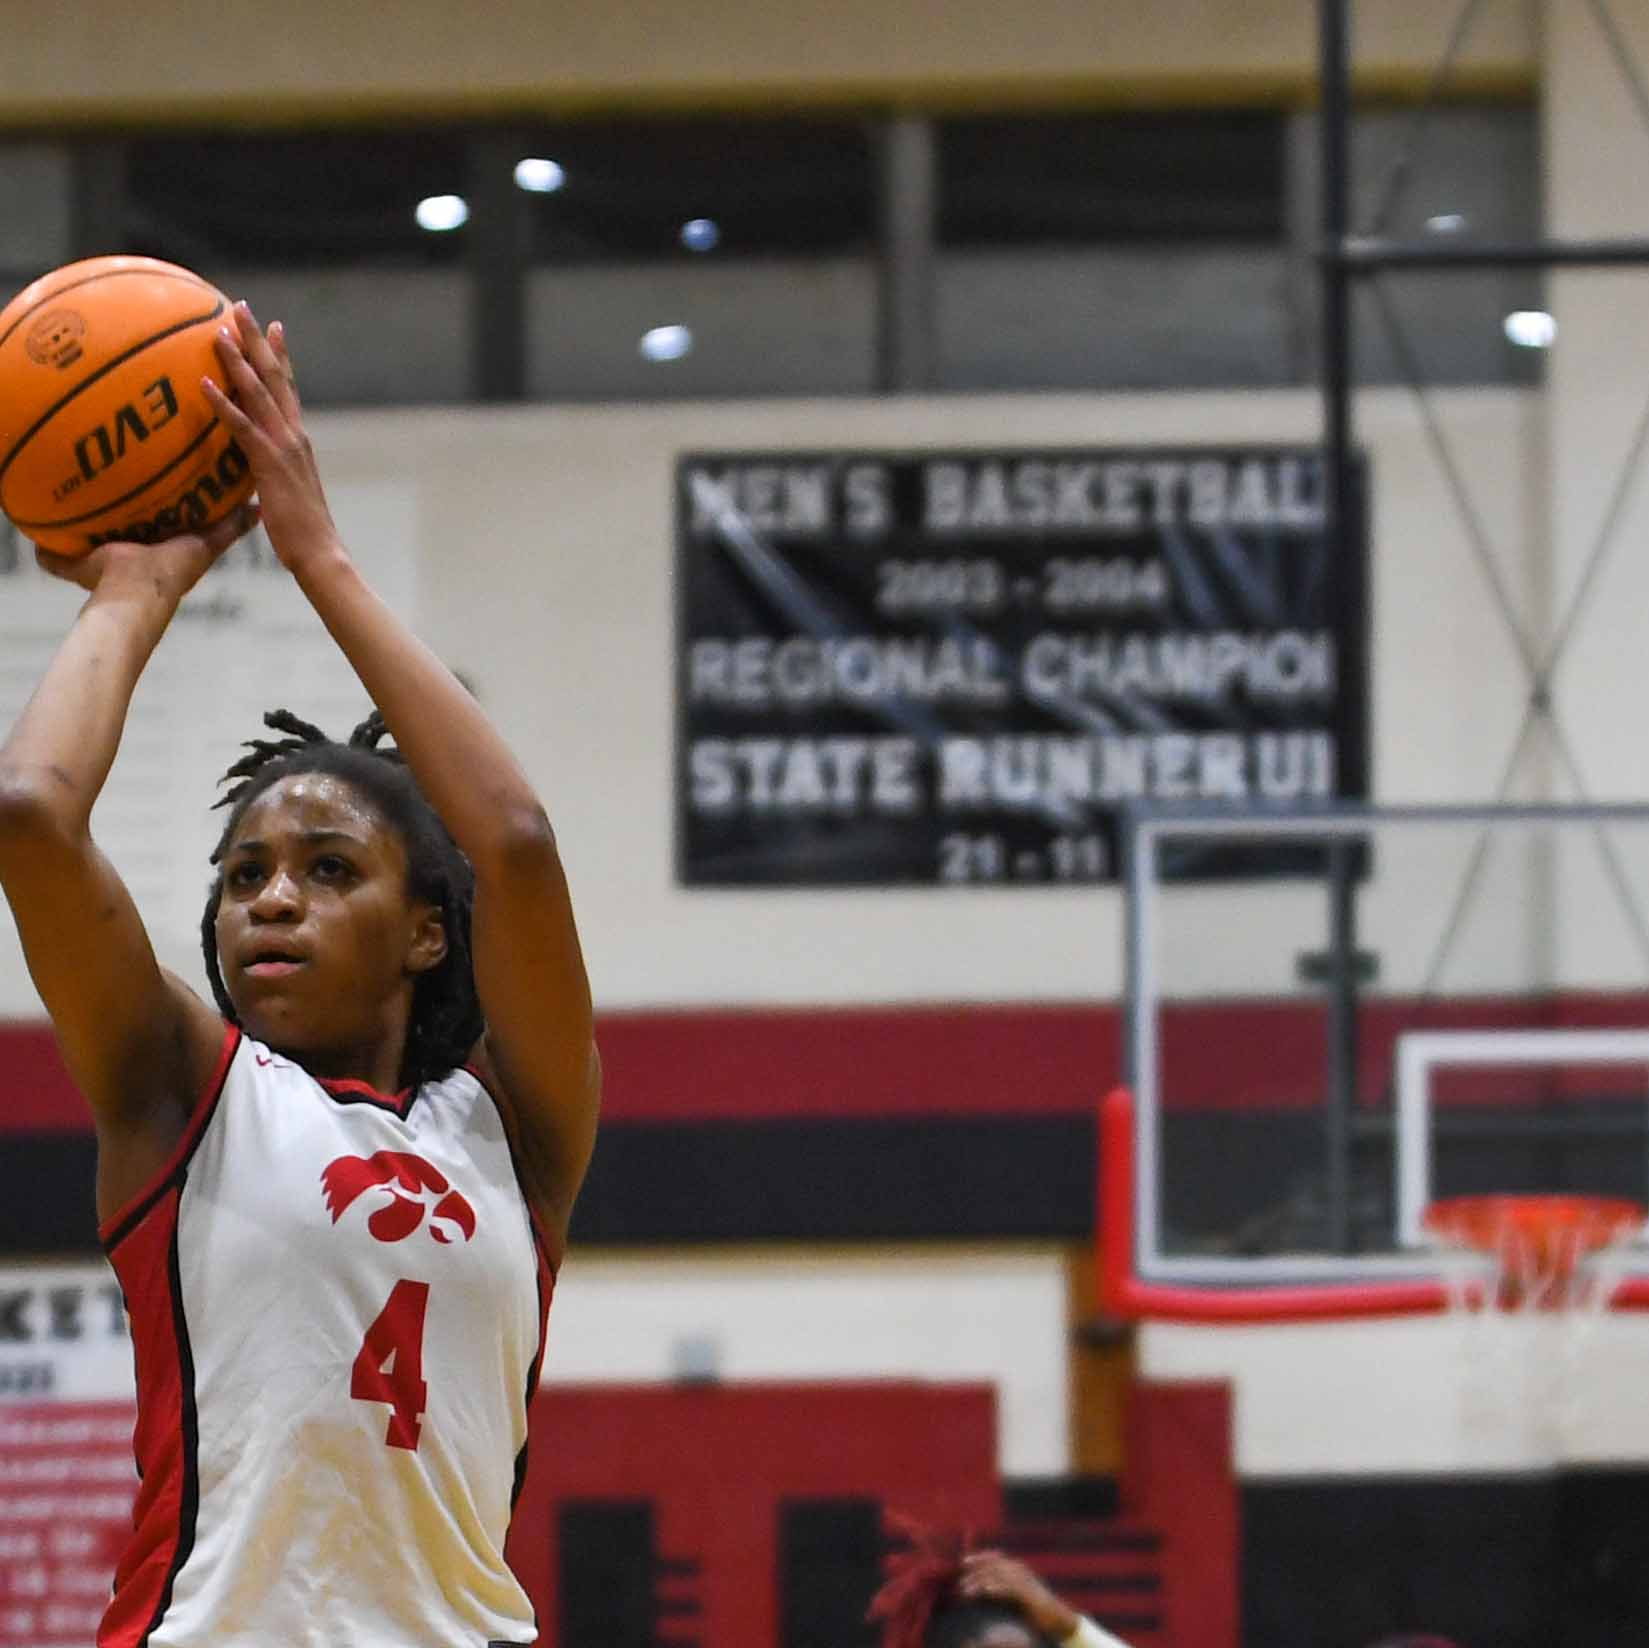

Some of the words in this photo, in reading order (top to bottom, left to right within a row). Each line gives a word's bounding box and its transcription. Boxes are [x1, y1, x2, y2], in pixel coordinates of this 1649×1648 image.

[74, 375, 178, 481] EVO
[920, 459, 1327, 531] BASKETBAL
[689, 634, 1008, 701] REGIONAL
[689, 736, 917, 808] STATE
[350, 1278, 430, 1451] 4
